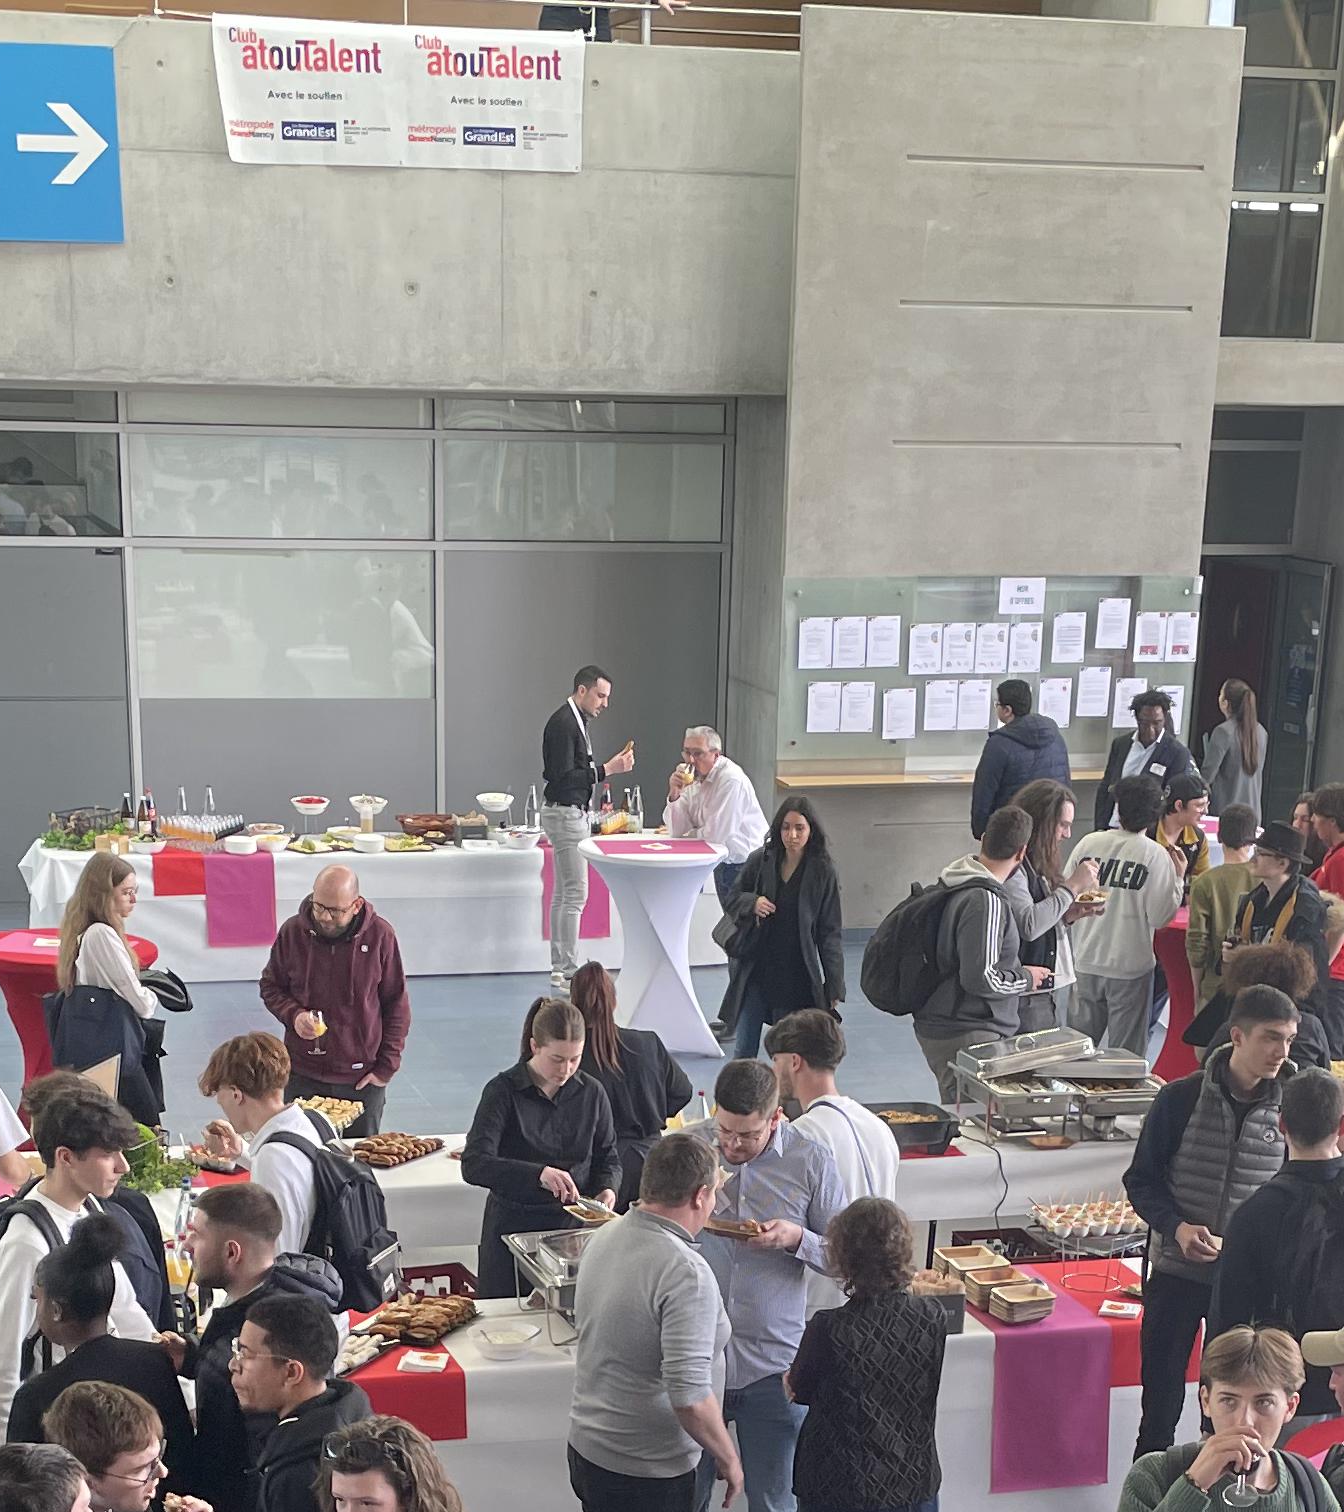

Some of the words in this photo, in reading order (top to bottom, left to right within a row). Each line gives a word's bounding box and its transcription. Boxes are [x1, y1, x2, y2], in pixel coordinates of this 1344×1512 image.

[229, 27, 257, 43] Club
[414, 34, 442, 49] Club
[242, 38, 382, 73] atouTalent
[427, 45, 562, 80] atouTalent
[267, 90, 293, 100] Avec
[296, 91, 305, 100] le
[307, 91, 342, 100] soutien
[450, 95, 474, 105] Avec
[478, 96, 487, 105] le
[489, 97, 523, 106] soutien
